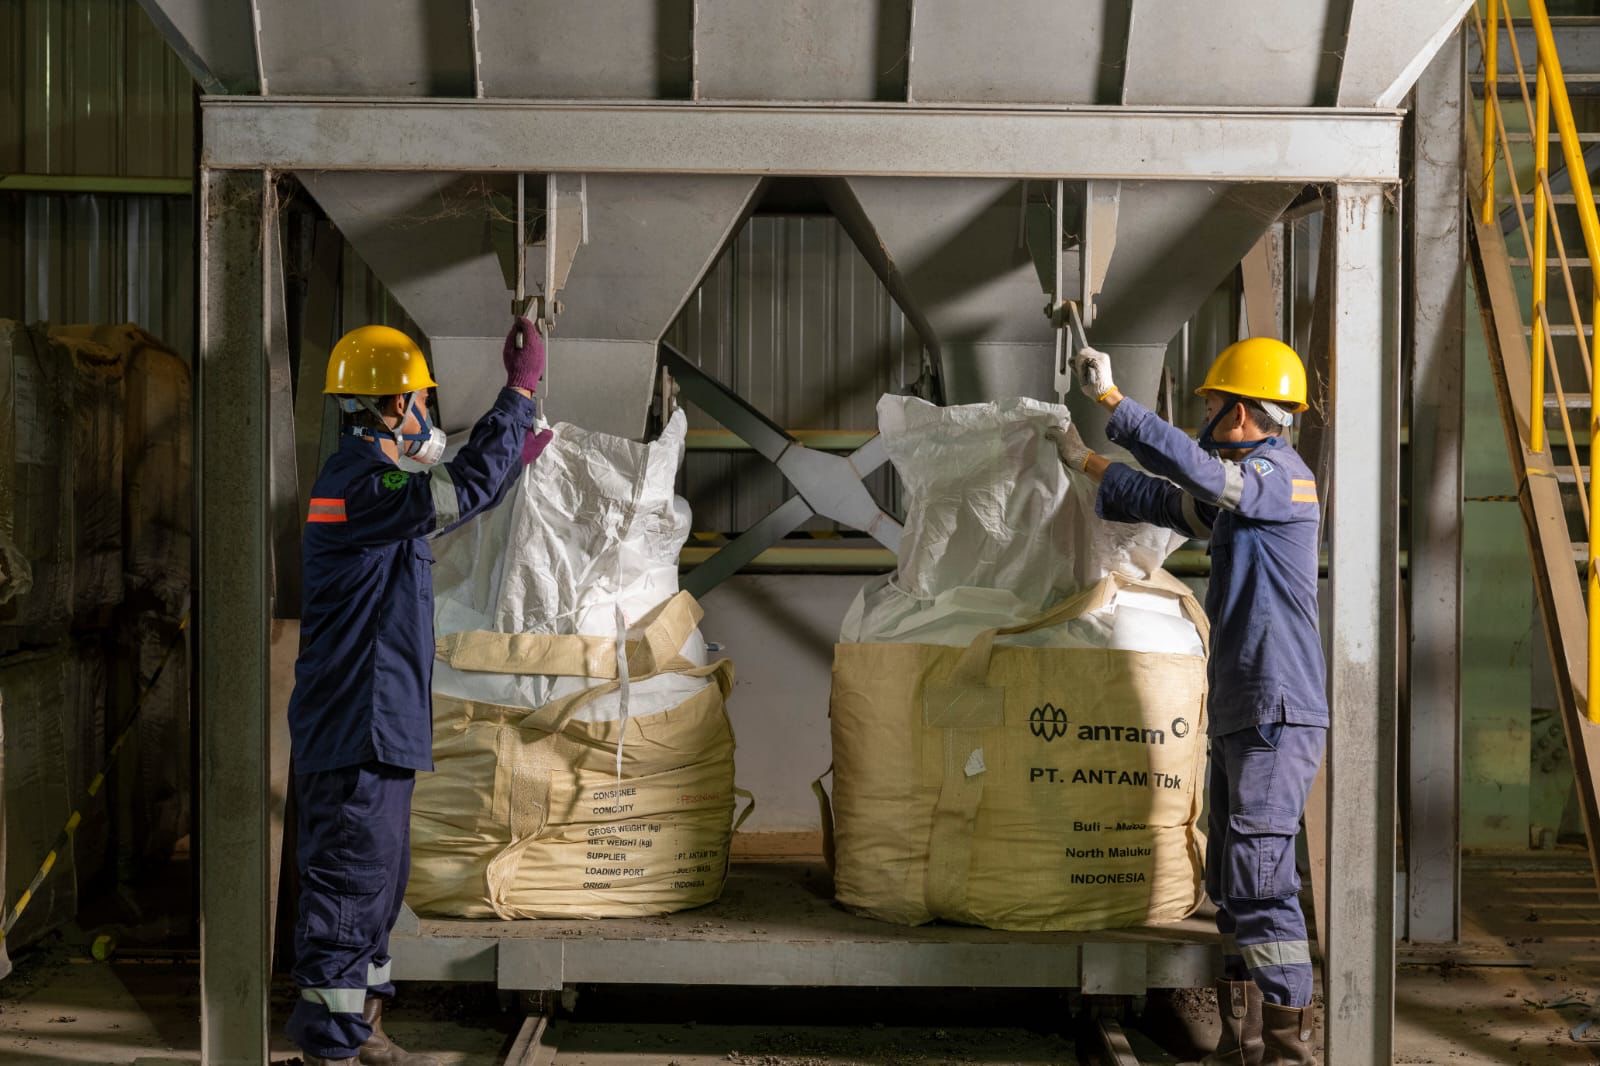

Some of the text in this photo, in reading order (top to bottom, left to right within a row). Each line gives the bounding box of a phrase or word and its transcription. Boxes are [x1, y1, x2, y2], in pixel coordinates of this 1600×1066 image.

[1078, 725, 1164, 744] antam
[1030, 768, 1181, 789] PT. ANTAM Tbk
[588, 824, 661, 836] GROSS WEIGHT (kg)
[1073, 822, 1100, 831] Buli
[639, 840, 652, 848] (kg)
[587, 852, 626, 861] SUPPLIER
[1066, 848, 1151, 858] North Maluku
[585, 867, 621, 875] LOADING
[1071, 874, 1145, 884] INDONESIA
